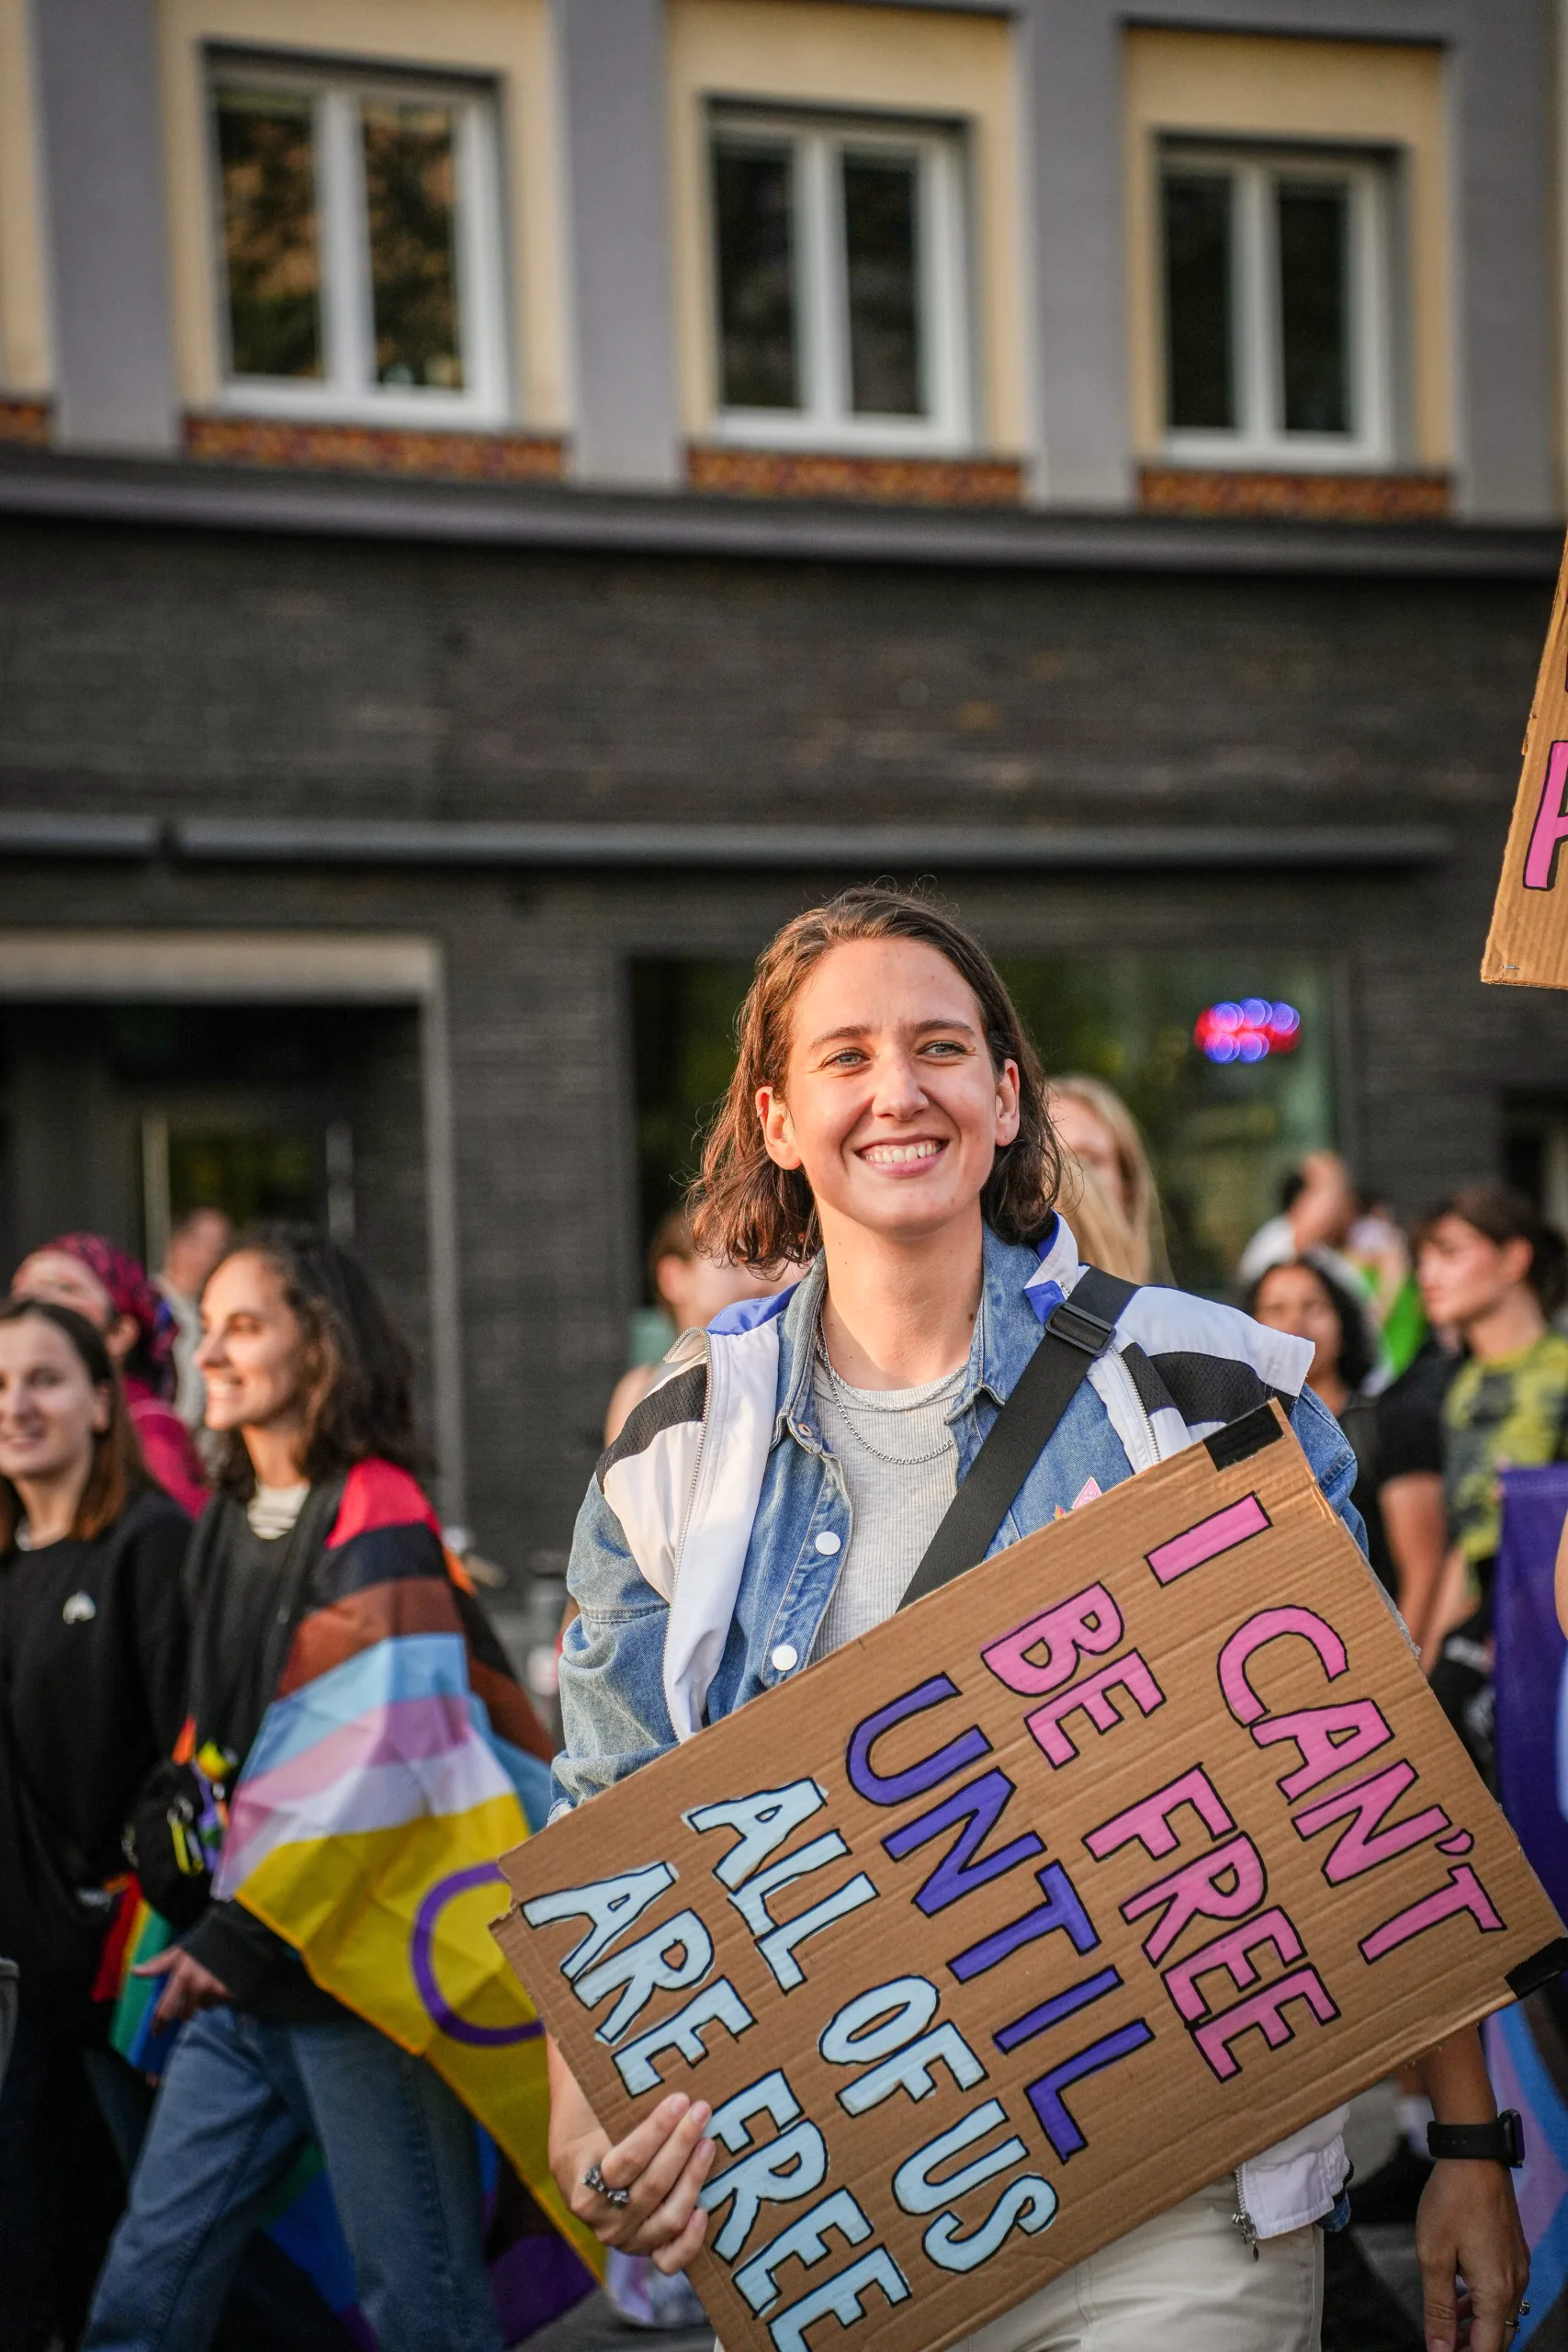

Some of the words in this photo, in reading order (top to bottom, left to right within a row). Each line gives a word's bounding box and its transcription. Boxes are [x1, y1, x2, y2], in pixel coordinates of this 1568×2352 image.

[682, 1776, 881, 1996] ALL
[845, 1671, 1156, 2165] UNTIL
[980, 1580, 1167, 1770] BE
[1080, 1762, 1342, 2084] FREE
[1145, 1491, 1273, 1588] I
[1216, 1604, 1507, 1964] CAN'T
[519, 1860, 758, 2098] ARE
[694, 2067, 913, 2352] FREE
[817, 1974, 990, 2119] OF
[891, 2097, 1059, 2274] US
